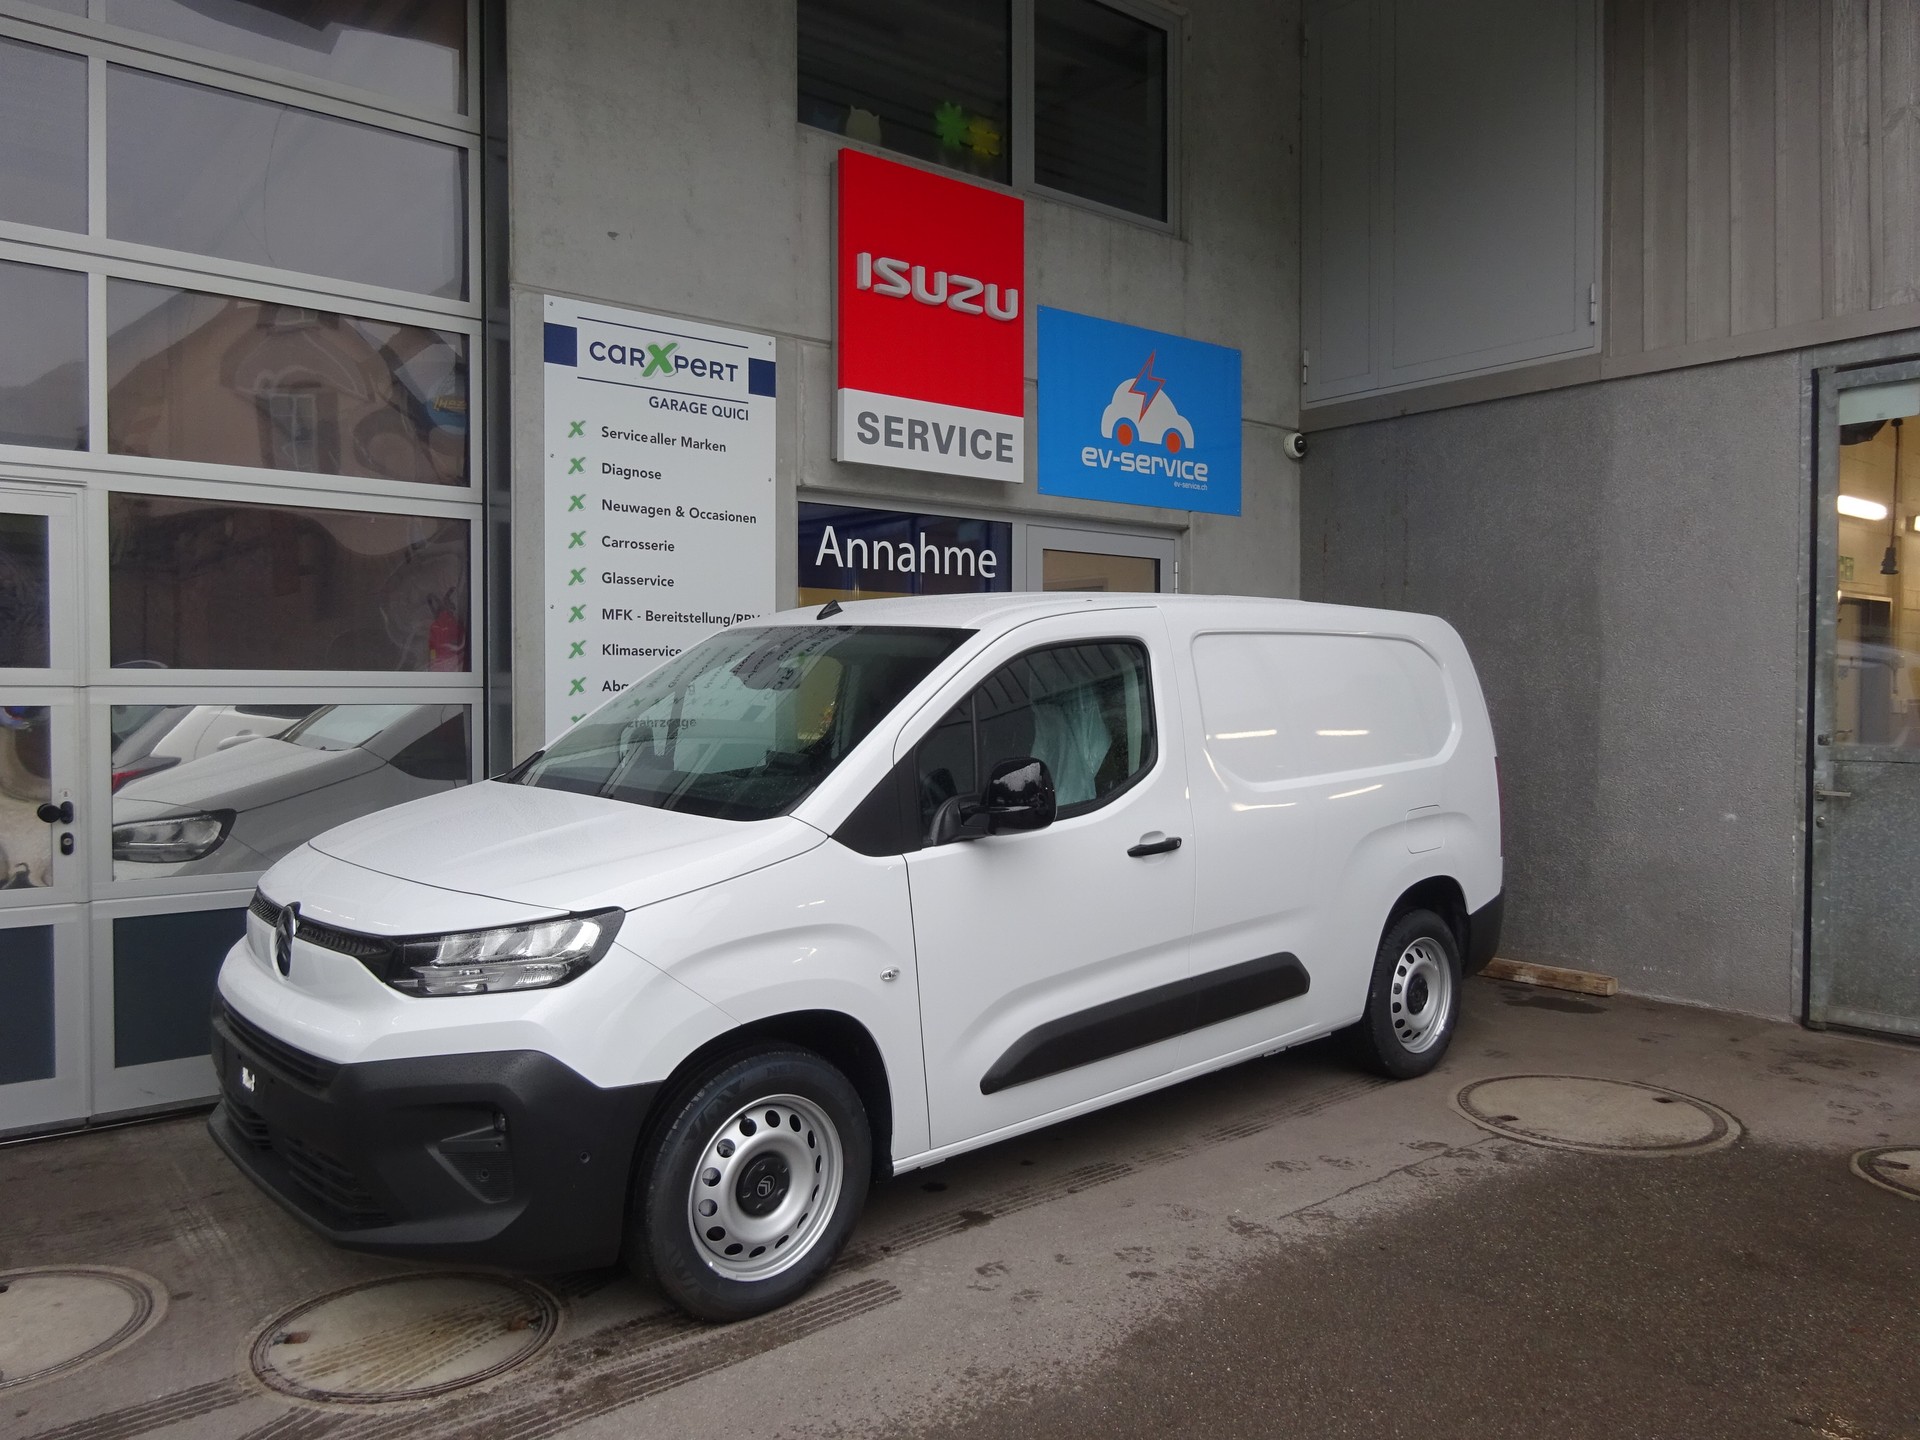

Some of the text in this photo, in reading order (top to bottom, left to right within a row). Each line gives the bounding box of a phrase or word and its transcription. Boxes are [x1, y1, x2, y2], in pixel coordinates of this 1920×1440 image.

[857, 252, 1019, 322] ISUZU
[648, 396, 749, 421] GARAGE QUICI
[601, 426, 727, 453] Service aller Marken
[856, 411, 1014, 464] SERVICE
[601, 462, 662, 480] Diagnose
[1081, 446, 1209, 482] ev-service
[601, 499, 757, 524] Neuwagen & Occasionen
[601, 535, 675, 552] Carrosserie
[815, 525, 997, 578] Annahme
[601, 572, 675, 588] Glasservice
[602, 608, 633, 621] MFK
[645, 610, 761, 627] Bereitstellung/R
[602, 643, 682, 657] Klimaservice
